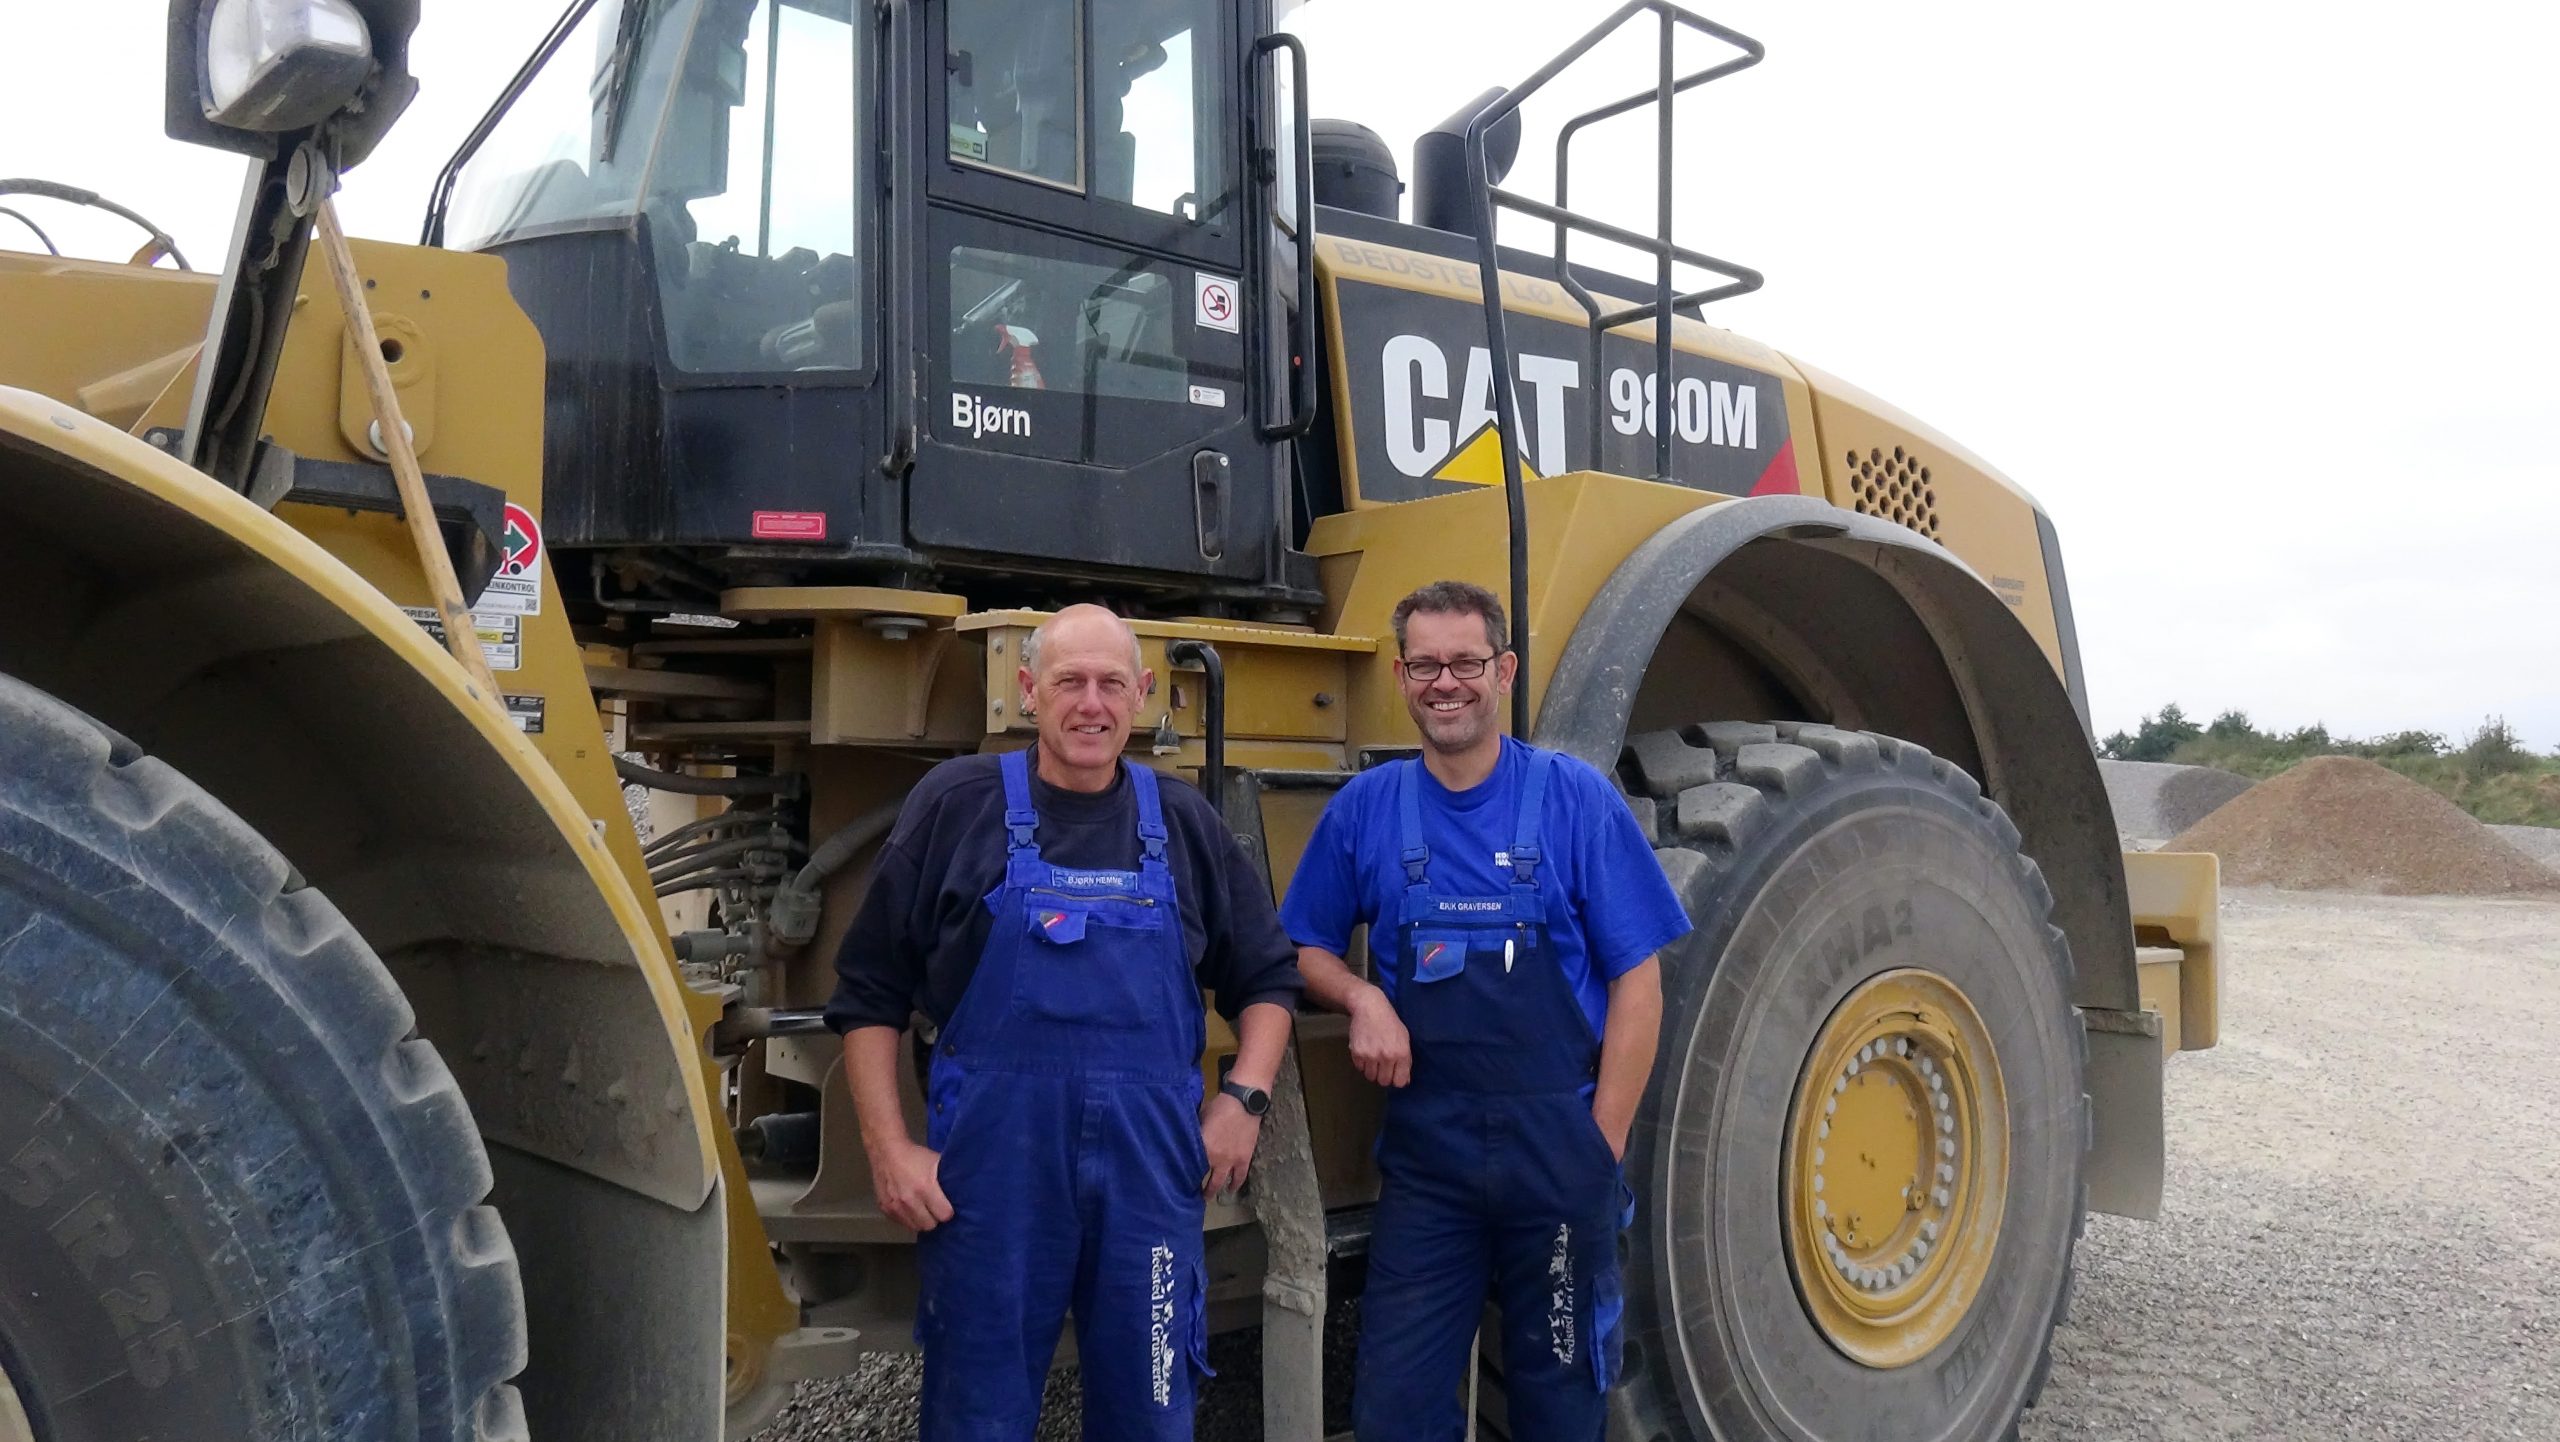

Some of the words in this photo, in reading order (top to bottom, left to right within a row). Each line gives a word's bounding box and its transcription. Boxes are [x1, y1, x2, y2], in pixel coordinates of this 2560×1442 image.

[1333, 242, 1481, 291] BEDSTE
[952, 392, 1031, 439] Bjørn
[1382, 334, 1579, 478] CAT
[489, 580, 536, 593] INKONTROL
[1439, 902, 1456, 910] ERIK
[1457, 902, 1502, 911] GRAVERSEN
[1151, 1246, 1164, 1300] Bedsted
